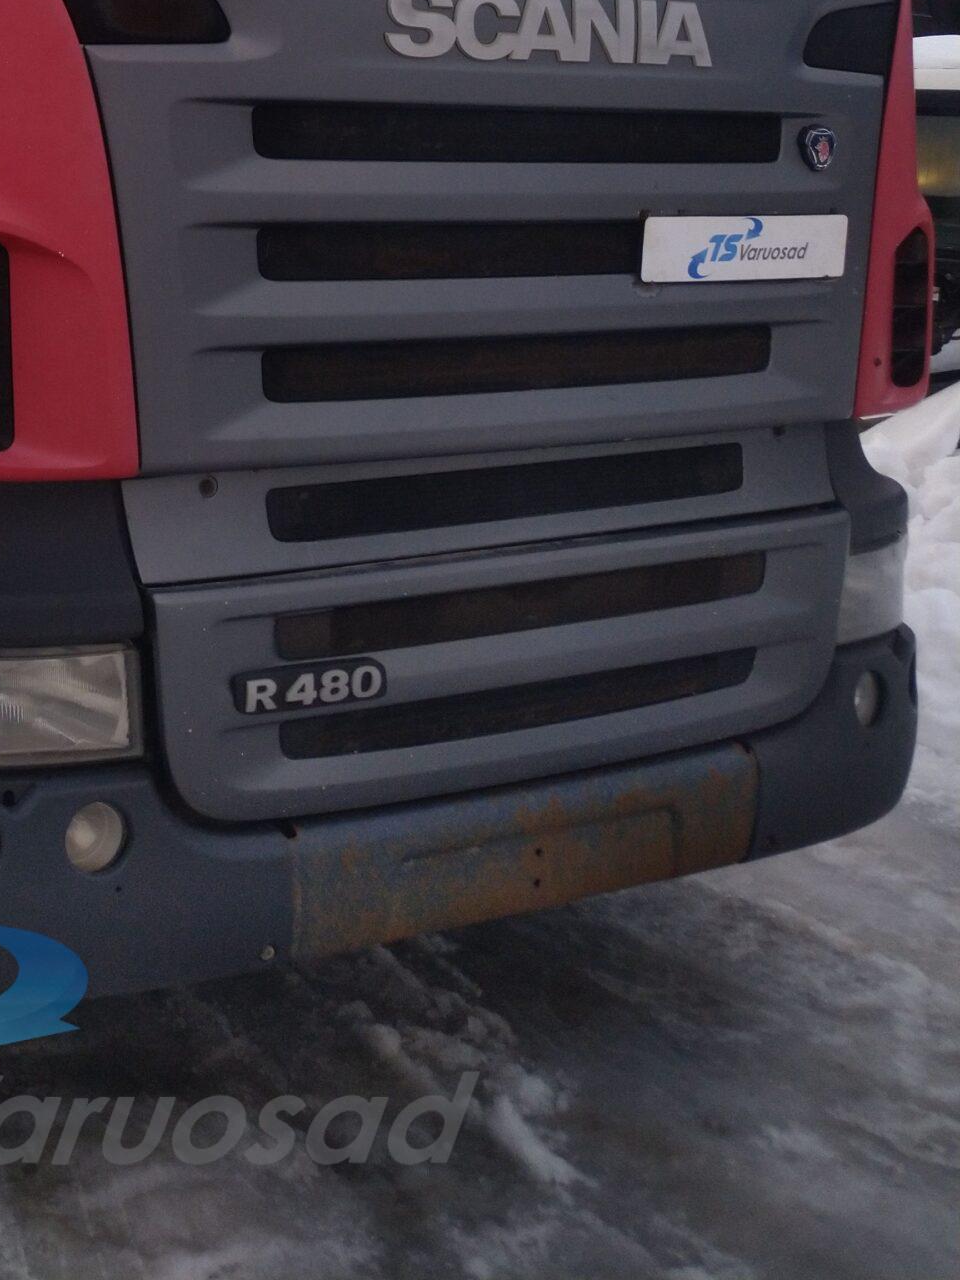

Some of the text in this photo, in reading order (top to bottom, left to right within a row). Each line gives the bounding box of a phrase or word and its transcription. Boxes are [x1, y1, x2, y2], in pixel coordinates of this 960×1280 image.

[708, 234, 809, 263] TS Varuosad
[244, 664, 383, 713] R 480
